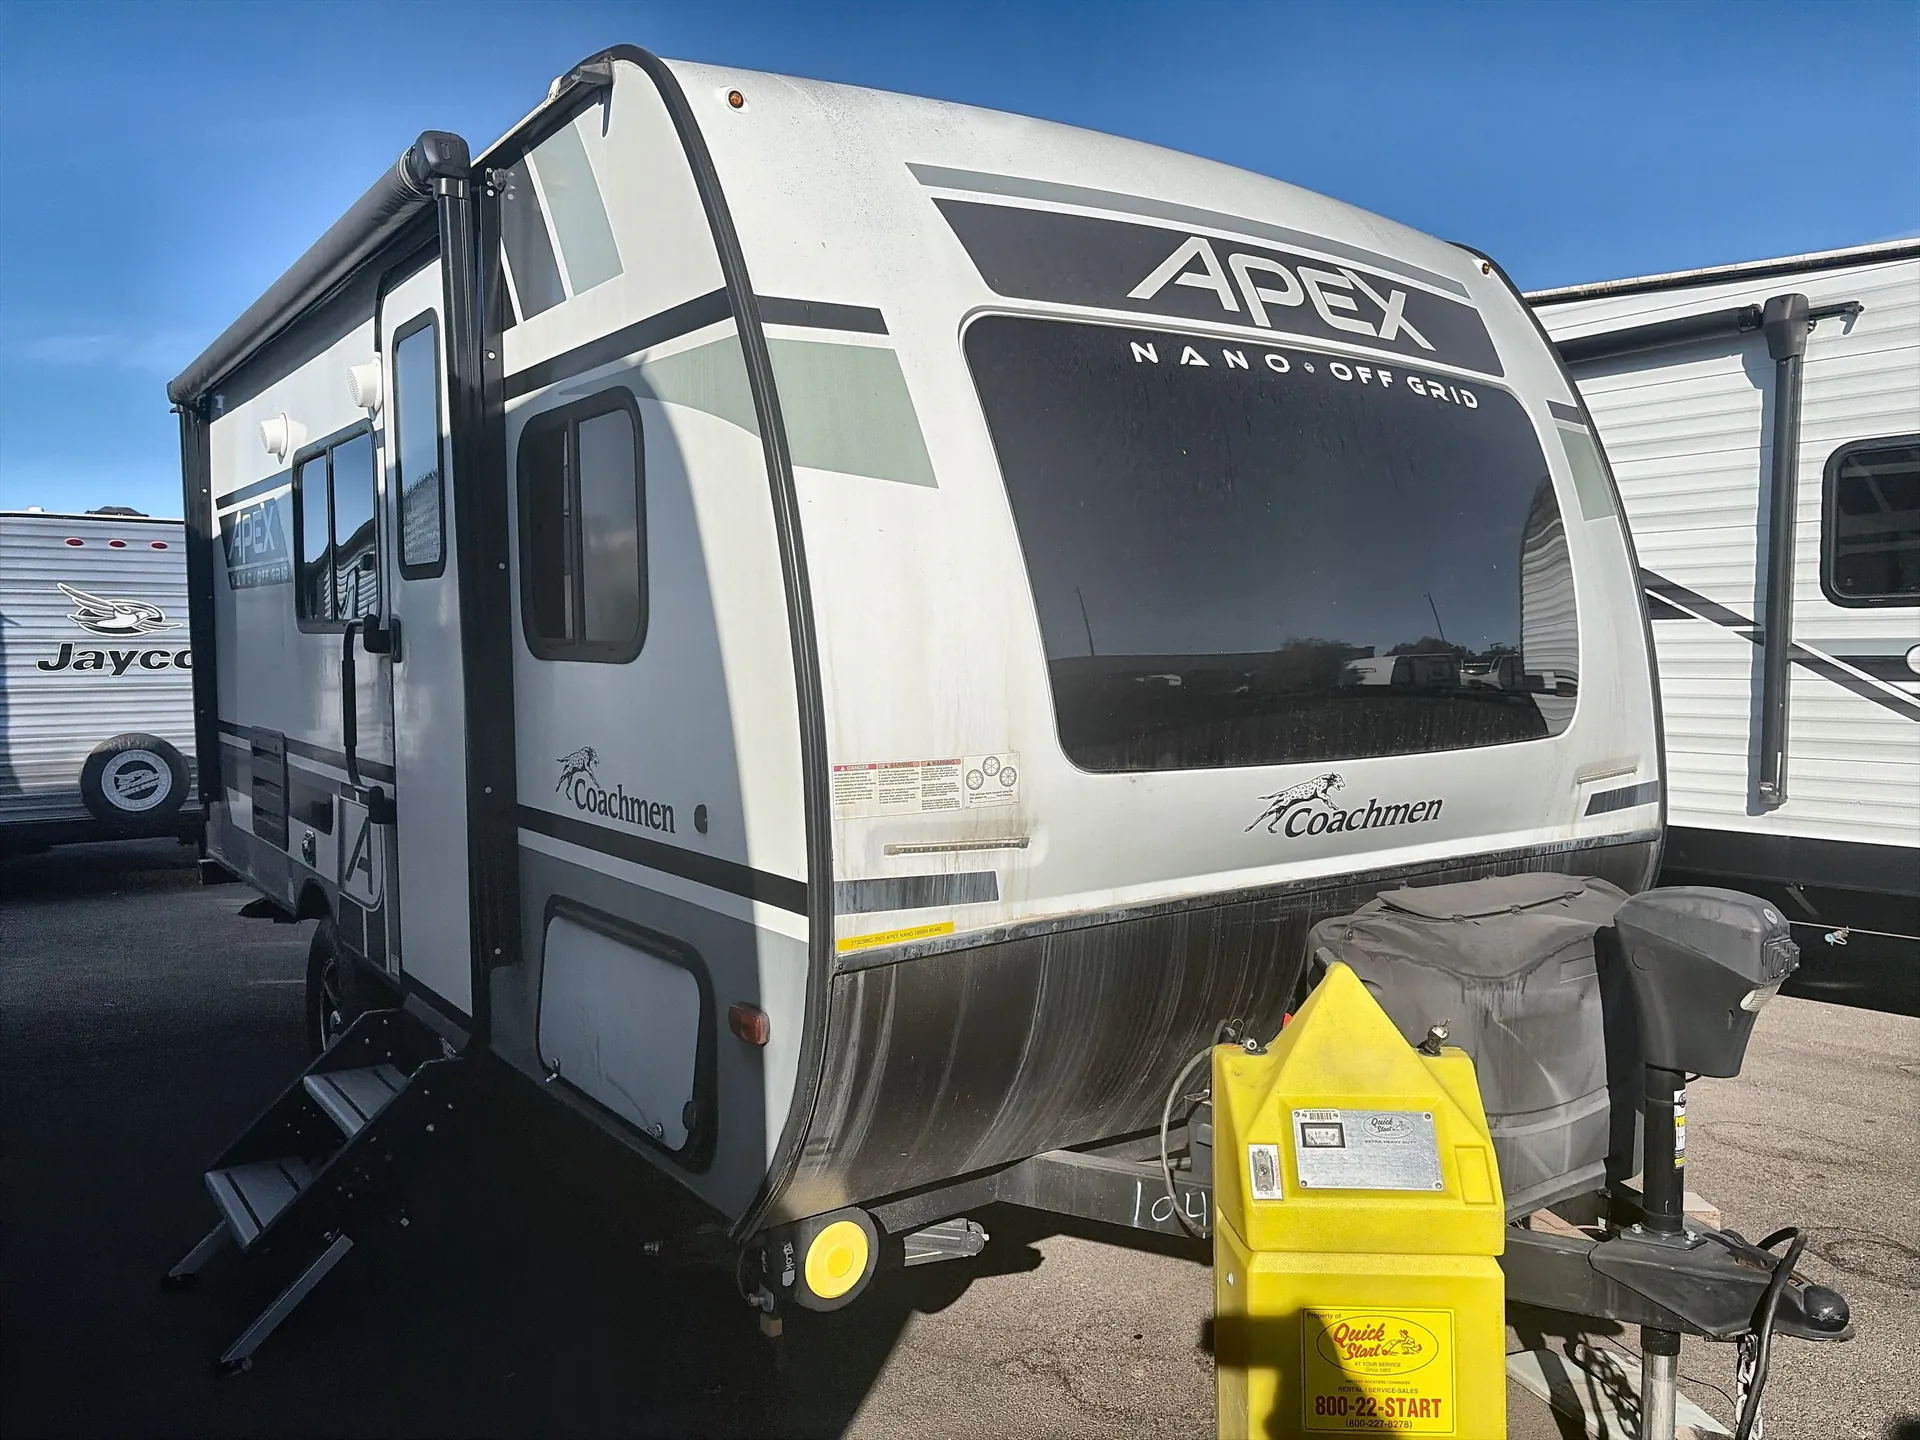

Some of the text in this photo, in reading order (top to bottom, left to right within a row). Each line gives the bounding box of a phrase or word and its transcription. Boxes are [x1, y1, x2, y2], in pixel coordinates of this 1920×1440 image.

[1126, 236, 1437, 352] APEX
[1129, 341, 1479, 410] NANO OFF GRID
[228, 502, 275, 564] APEX
[271, 566, 289, 581] GRID
[574, 778, 676, 834] Coachmen
[1284, 798, 1443, 838] Coachmen
[1371, 1117, 1394, 1128] Quick
[1376, 1125, 1393, 1133] Start
[1134, 1181, 1207, 1239] 104
[1307, 1312, 1334, 1320] Property
[1333, 1322, 1386, 1349] Quick
[1342, 1342, 1382, 1361] Start
[1315, 1396, 1442, 1418] 800-22-START
[1346, 1419, 1413, 1429] (800-227-8278)
